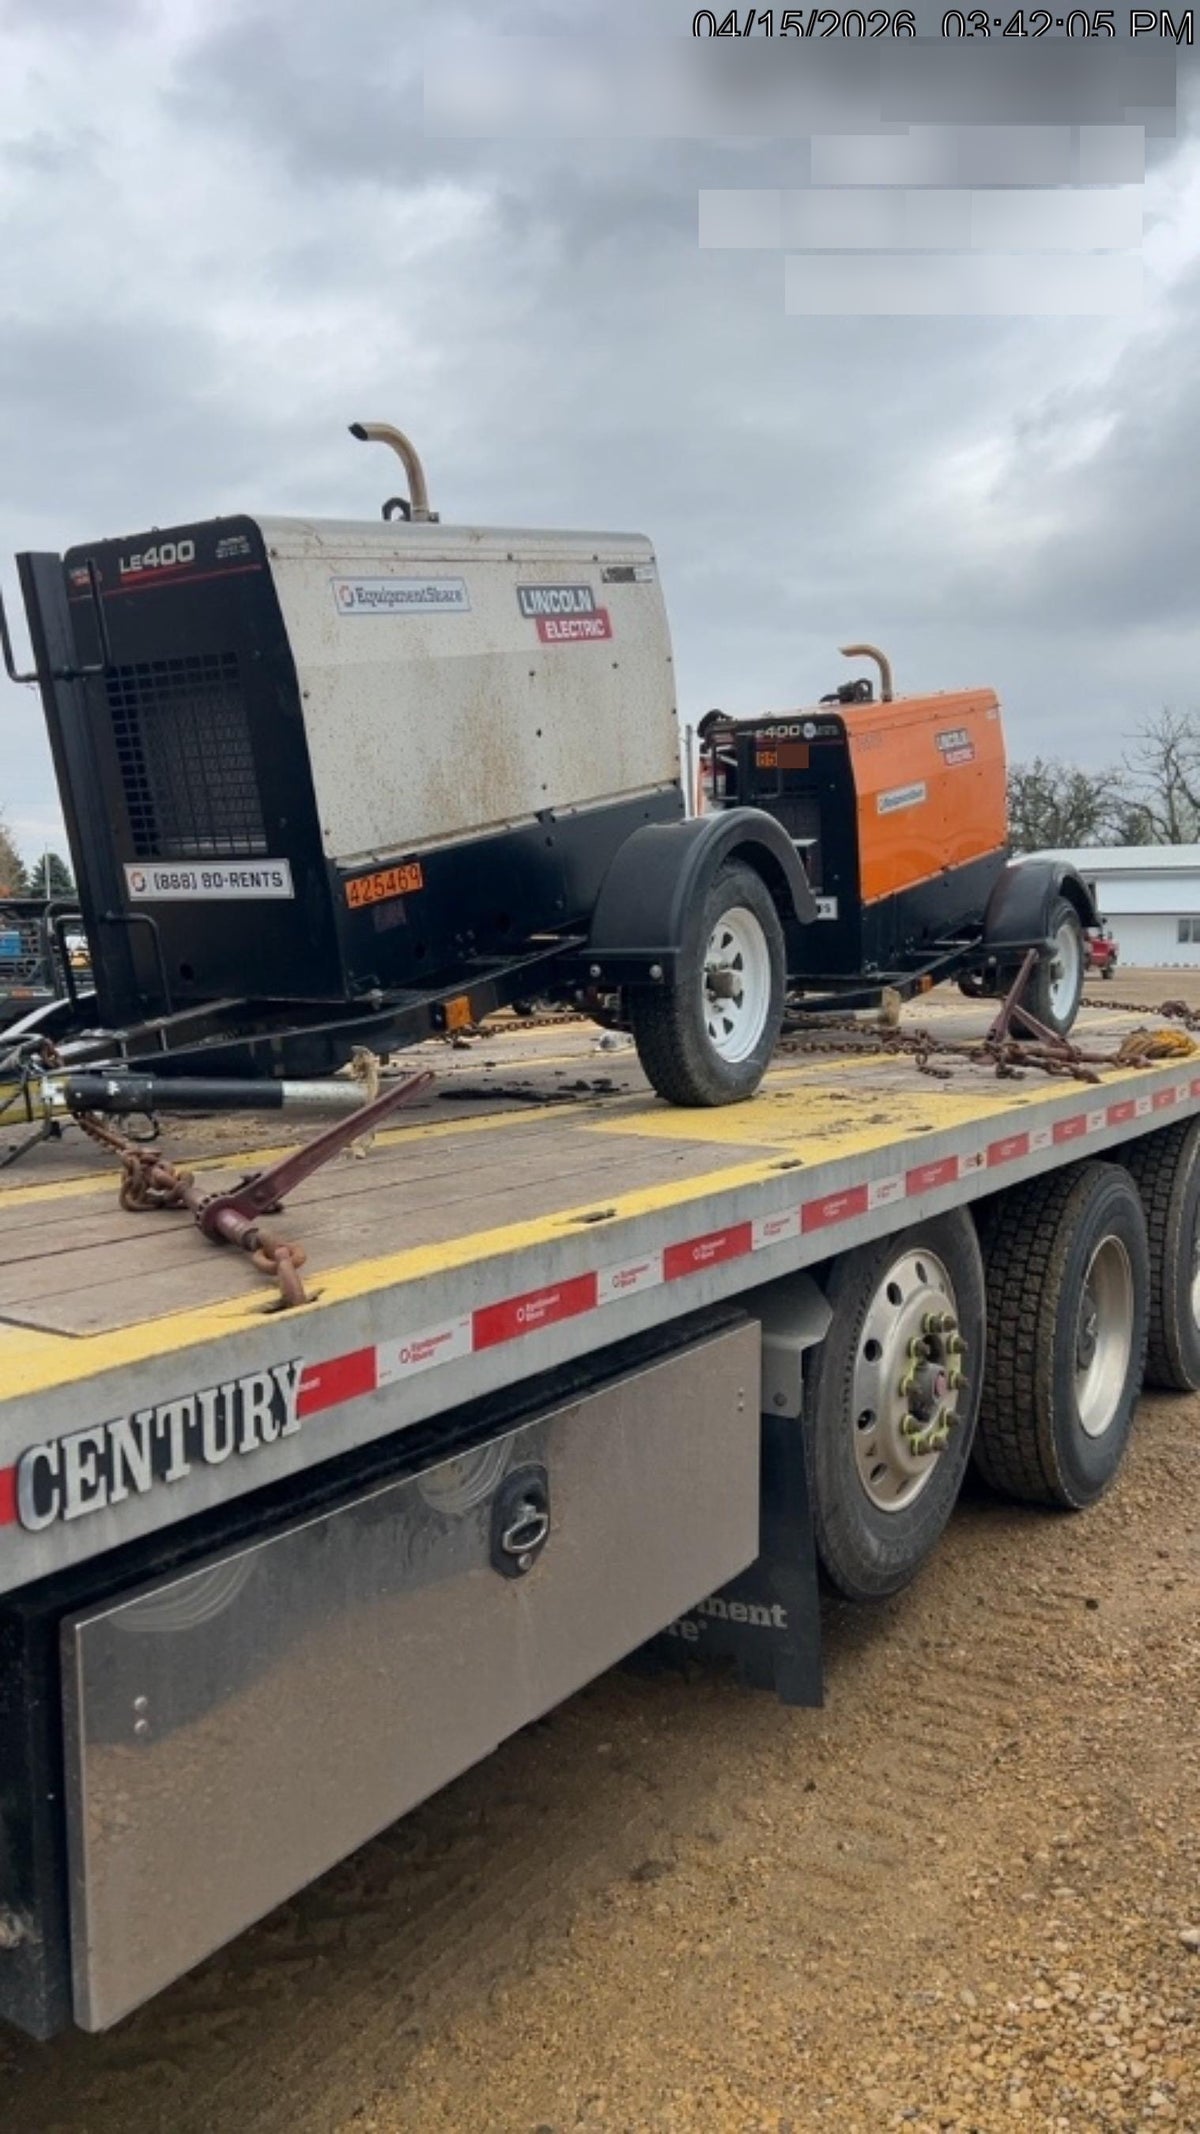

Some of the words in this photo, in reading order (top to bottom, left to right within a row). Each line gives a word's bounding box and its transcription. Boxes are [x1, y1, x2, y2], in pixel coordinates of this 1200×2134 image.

[118, 539, 196, 575] LE400
[520, 588, 594, 615] LINCOLN
[544, 617, 606, 639] ELECTRIC
[350, 865, 419, 904] 425469
[16, 1356, 304, 1533] CENTURY
